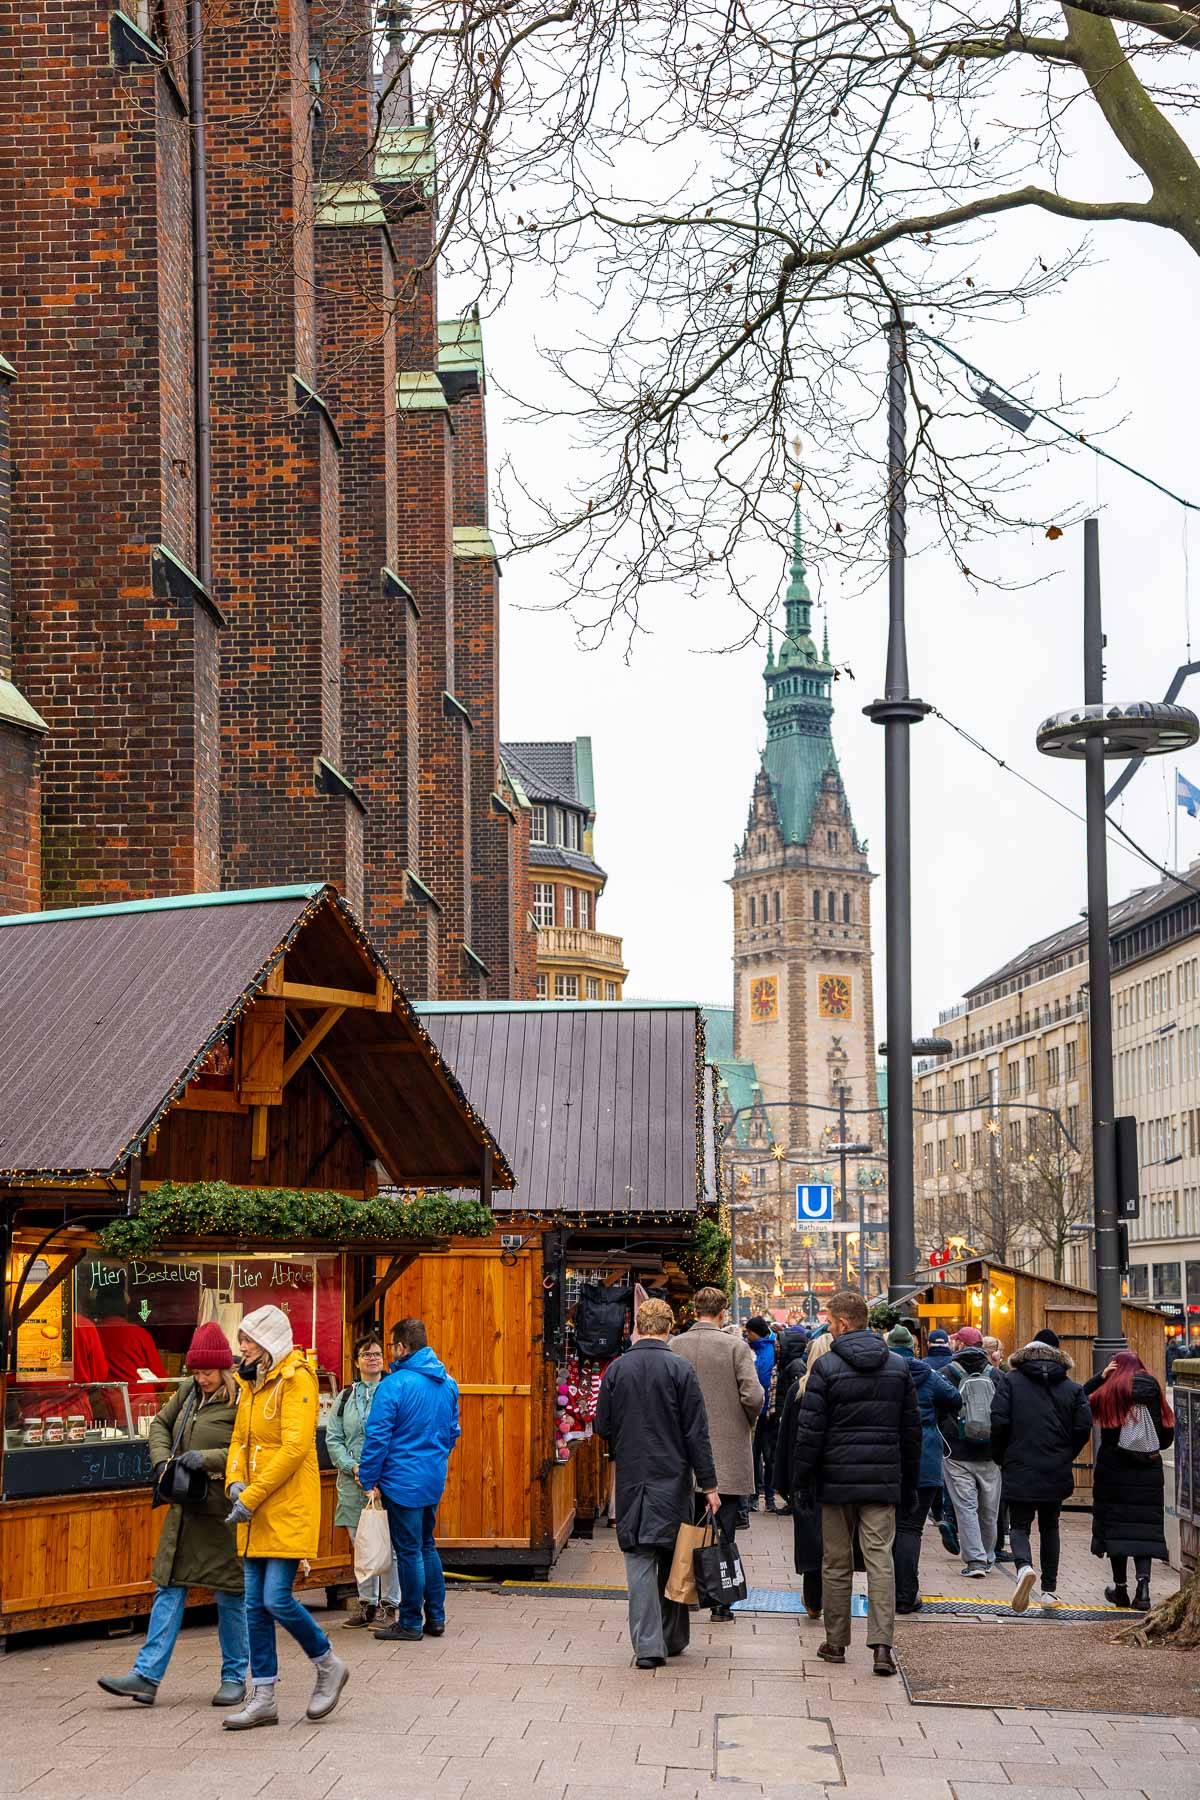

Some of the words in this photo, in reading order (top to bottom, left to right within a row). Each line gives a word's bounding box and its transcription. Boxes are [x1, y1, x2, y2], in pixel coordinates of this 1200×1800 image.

[802, 1187, 828, 1217] U
[798, 1223, 828, 1231] Rathaus
[90, 1261, 127, 1290] Hier
[129, 1260, 207, 1286] Bestellen
[230, 1261, 263, 1288] Hier
